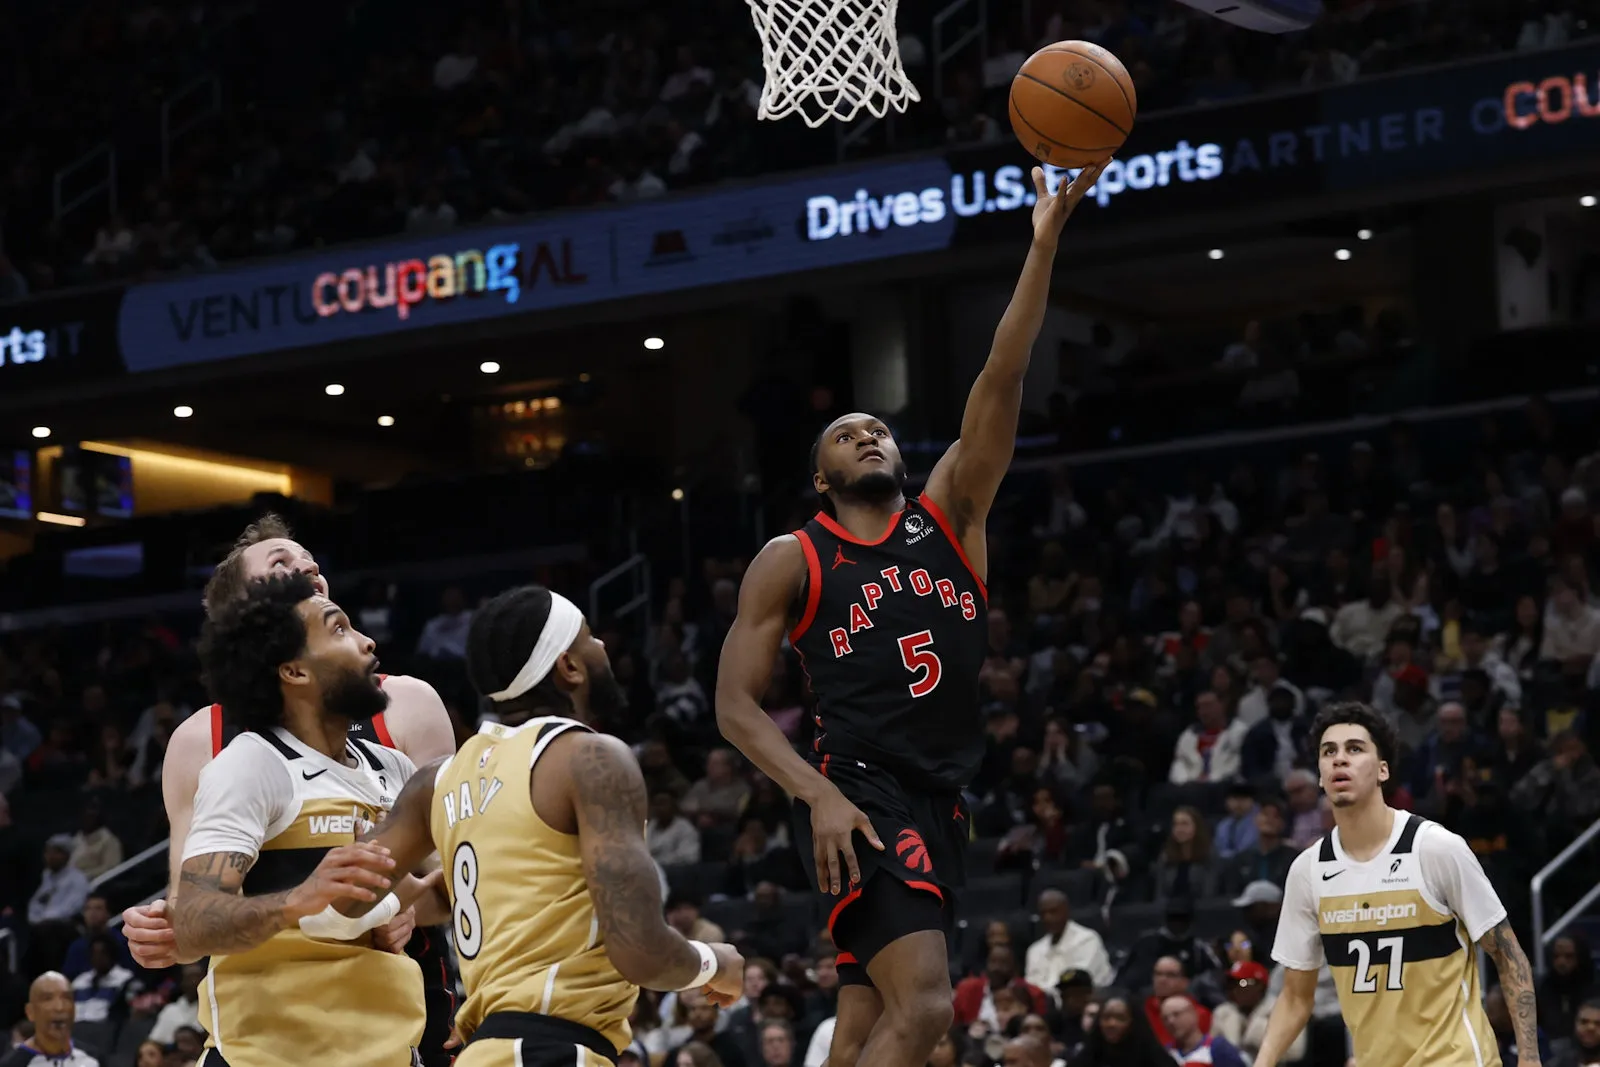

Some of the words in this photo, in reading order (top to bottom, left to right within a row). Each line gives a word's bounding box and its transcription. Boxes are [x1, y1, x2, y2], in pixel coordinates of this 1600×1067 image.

[1229, 108, 1445, 175] ARTNER
[805, 188, 946, 241] Drives
[951, 164, 1037, 218] U.S.
[168, 280, 318, 343] VENTU
[311, 242, 521, 320] coupang
[905, 534, 922, 546] Sun
[920, 526, 935, 539] Life
[829, 565, 977, 658] RAPTORS
[897, 629, 942, 698] 5
[452, 841, 483, 960] 8
[1322, 902, 1417, 925] washington
[1348, 936, 1404, 994] 27
